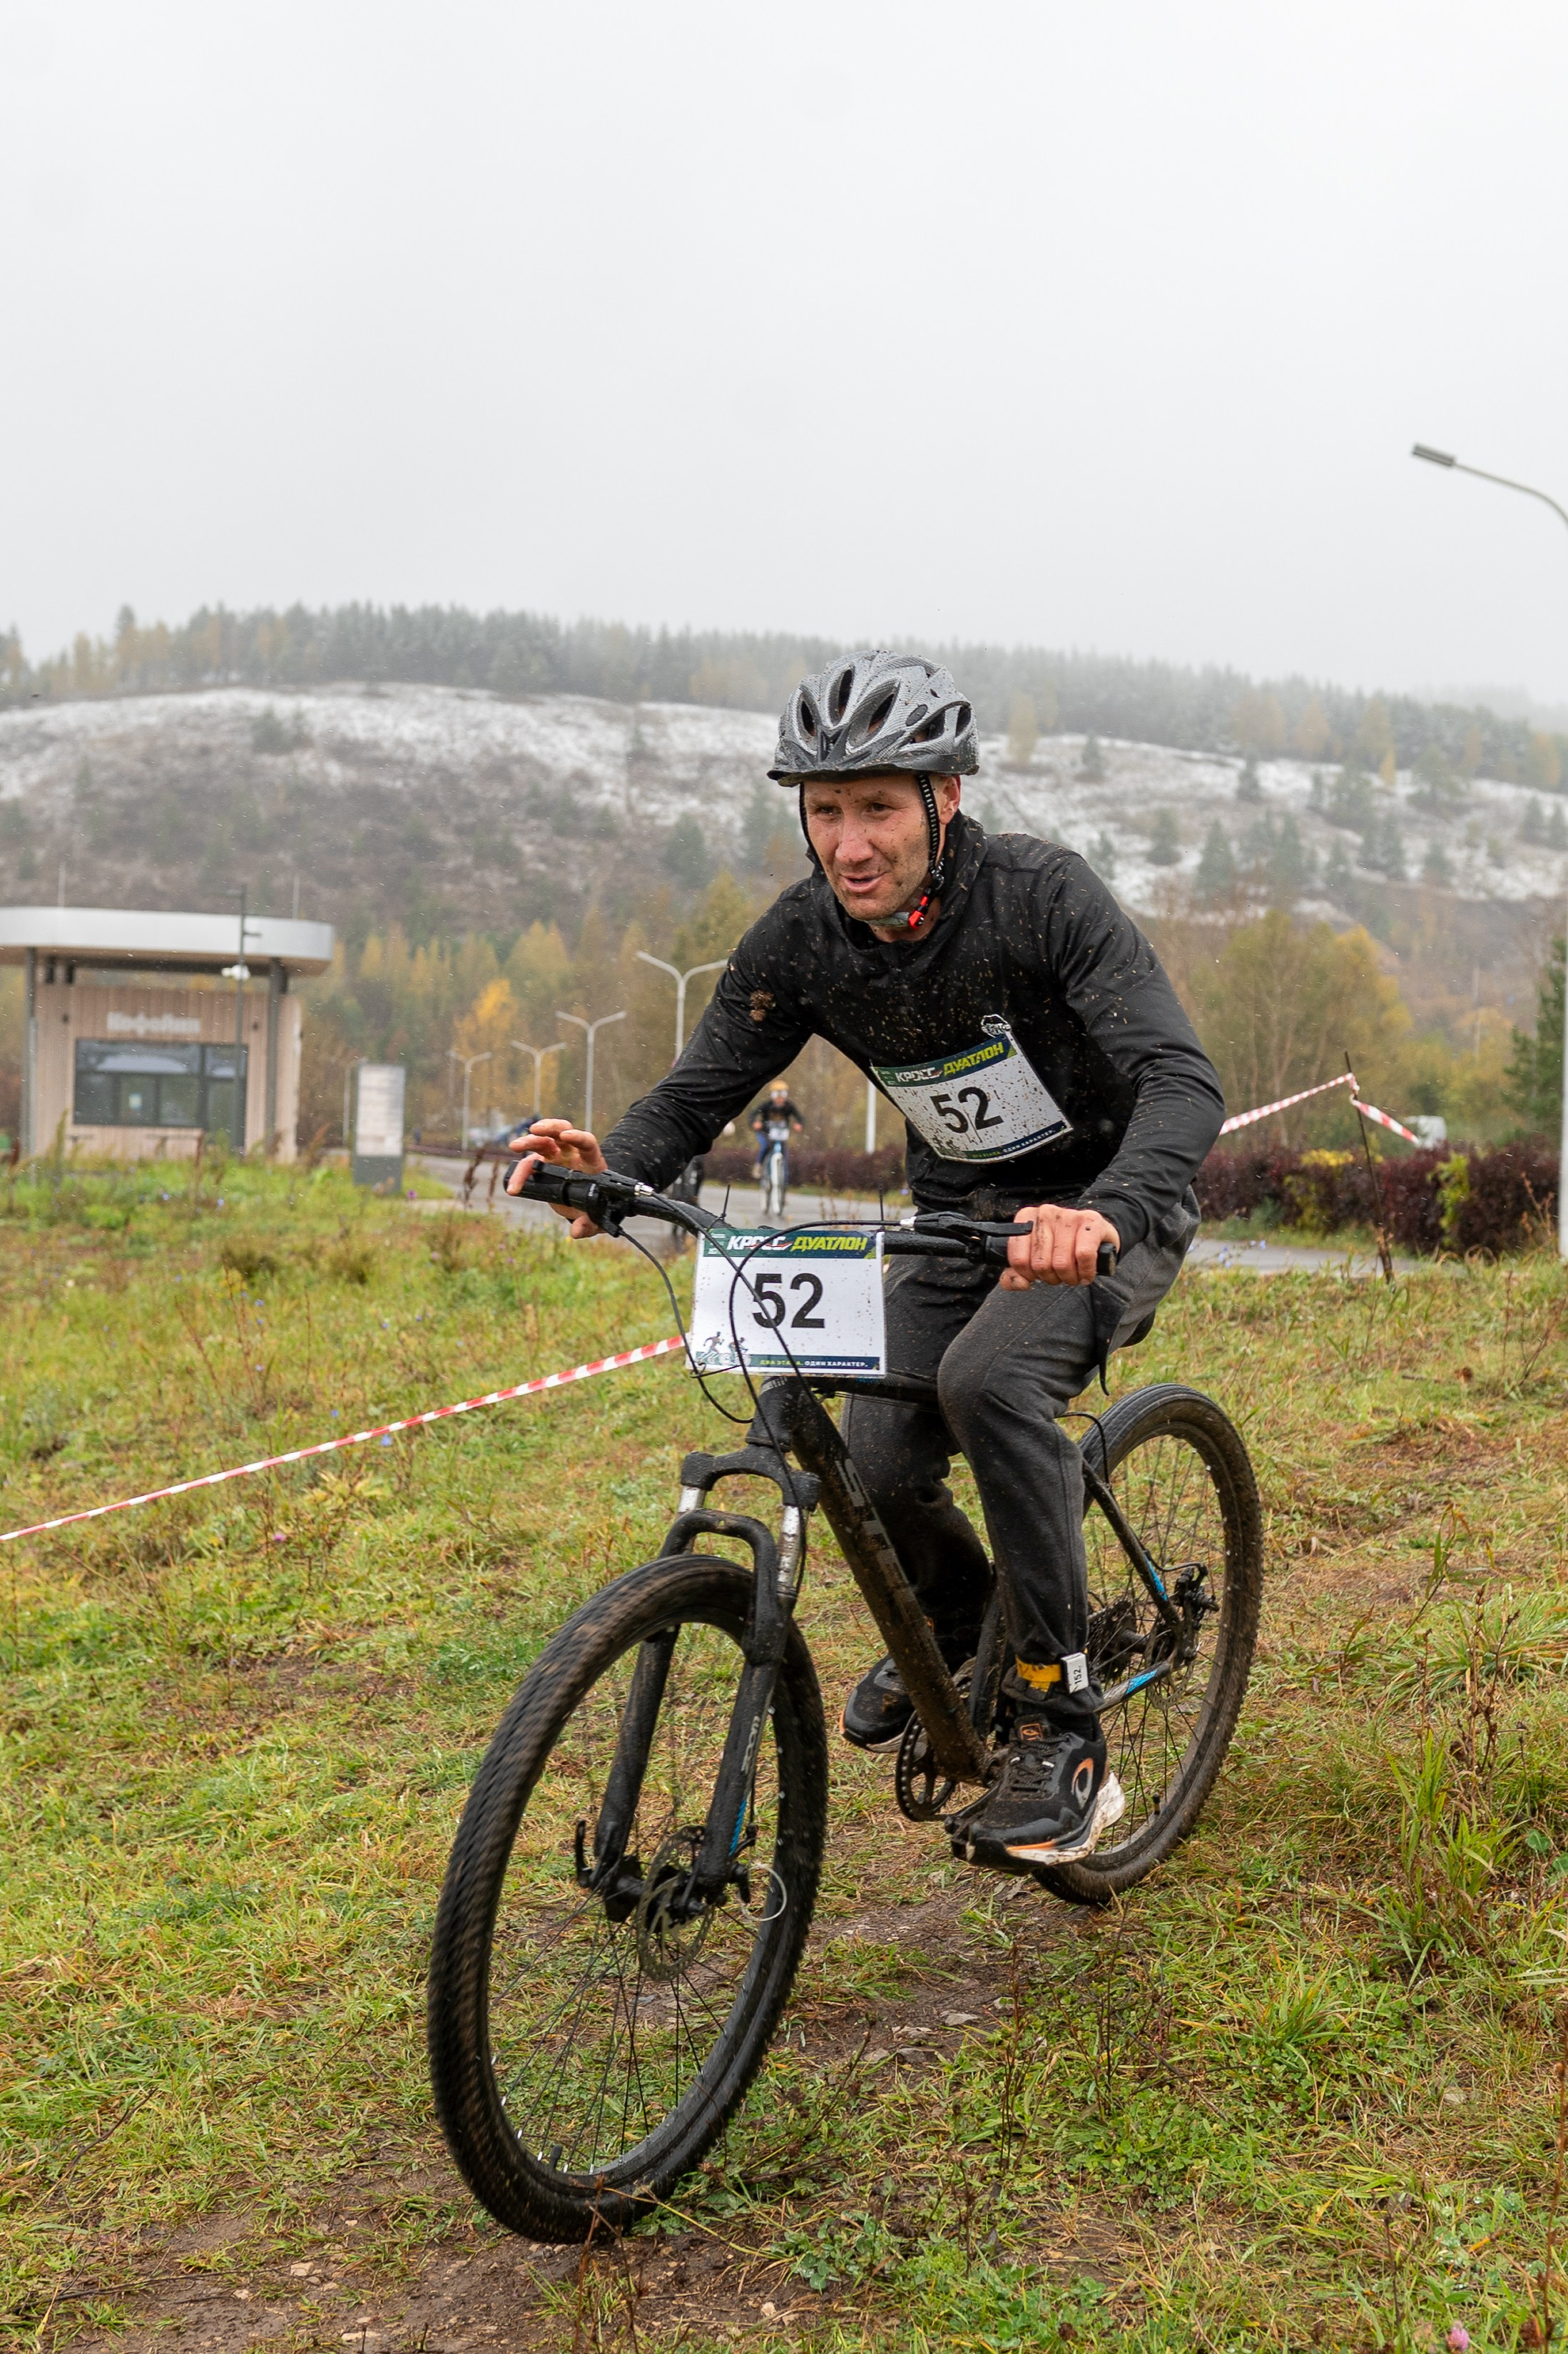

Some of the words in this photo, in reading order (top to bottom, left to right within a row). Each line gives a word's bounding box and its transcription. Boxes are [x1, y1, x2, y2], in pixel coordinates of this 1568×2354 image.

[943, 1041, 1004, 1076] ДУАТЛОН
[930, 1086, 1004, 1134] 52
[790, 1236, 868, 1253] ДУАТЛОН
[752, 1273, 825, 1329] 52
